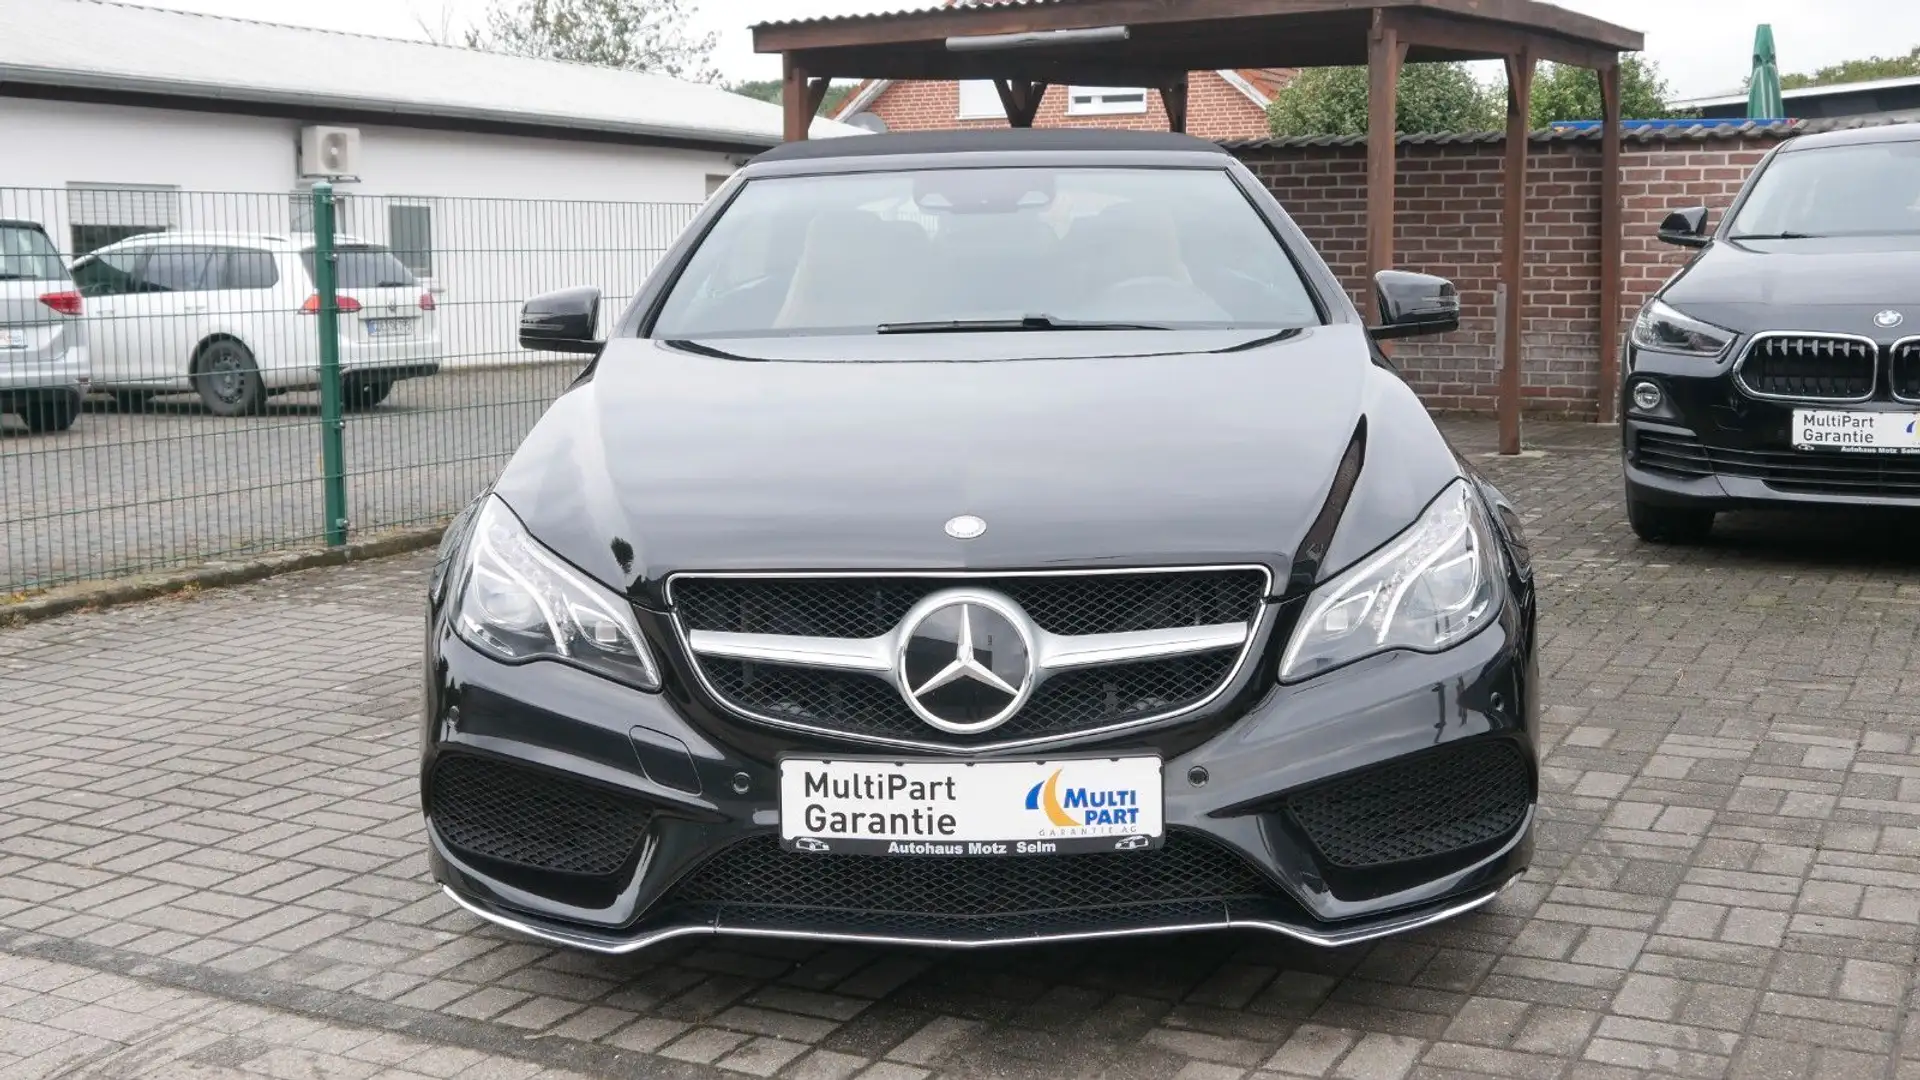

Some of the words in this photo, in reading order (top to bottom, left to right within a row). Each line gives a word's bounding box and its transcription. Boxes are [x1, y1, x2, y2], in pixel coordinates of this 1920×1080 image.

[1803, 414, 1874, 429] MultiPart
[1803, 428, 1874, 443] Garantie
[804, 771, 956, 801] MultiPart
[1063, 787, 1137, 809] MULTI
[804, 803, 957, 836] Garantie
[1084, 807, 1139, 826] PART
[1038, 827, 1115, 837] GARANTIE
[1121, 825, 1138, 834] AG
[888, 841, 964, 855] Autohaus
[968, 842, 1007, 855] Motz
[1016, 841, 1057, 853] Selm
